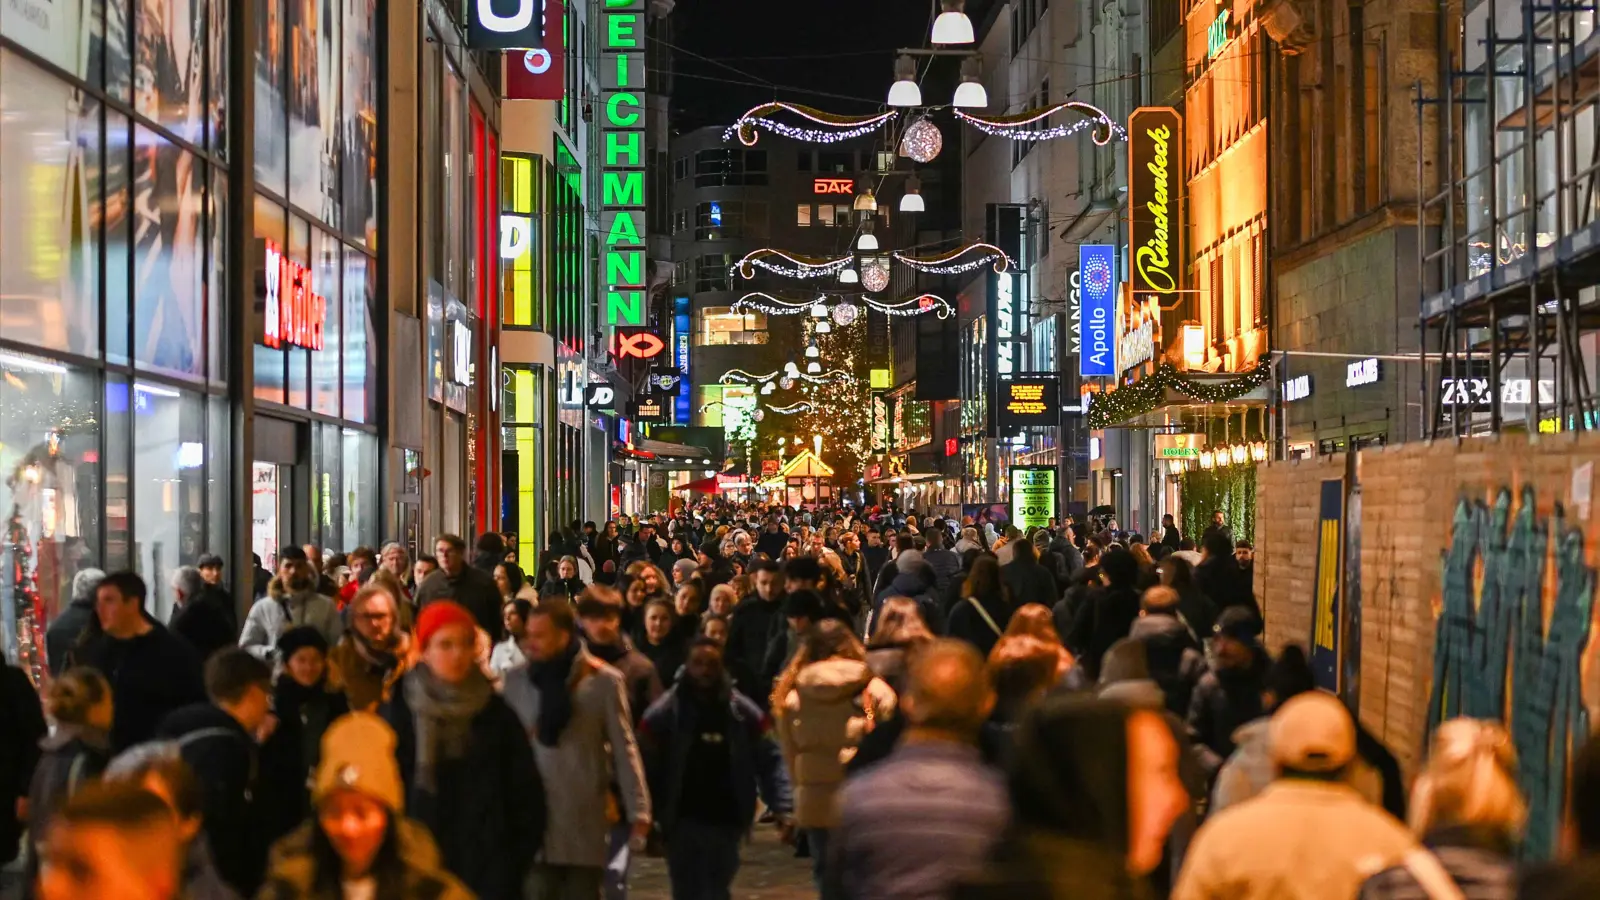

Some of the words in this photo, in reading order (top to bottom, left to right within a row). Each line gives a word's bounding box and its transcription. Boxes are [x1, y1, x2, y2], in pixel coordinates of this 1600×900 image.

[604, 0, 643, 324] EICHMANN
[814, 179, 853, 193] DAK
[1136, 123, 1175, 294] Rüschenbeck
[1069, 270, 1080, 353] MANGO
[1089, 307, 1109, 366] Apollo
[589, 387, 614, 405] JD
[1163, 448, 1199, 457] ROLEX
[1018, 506, 1050, 516] 50%
